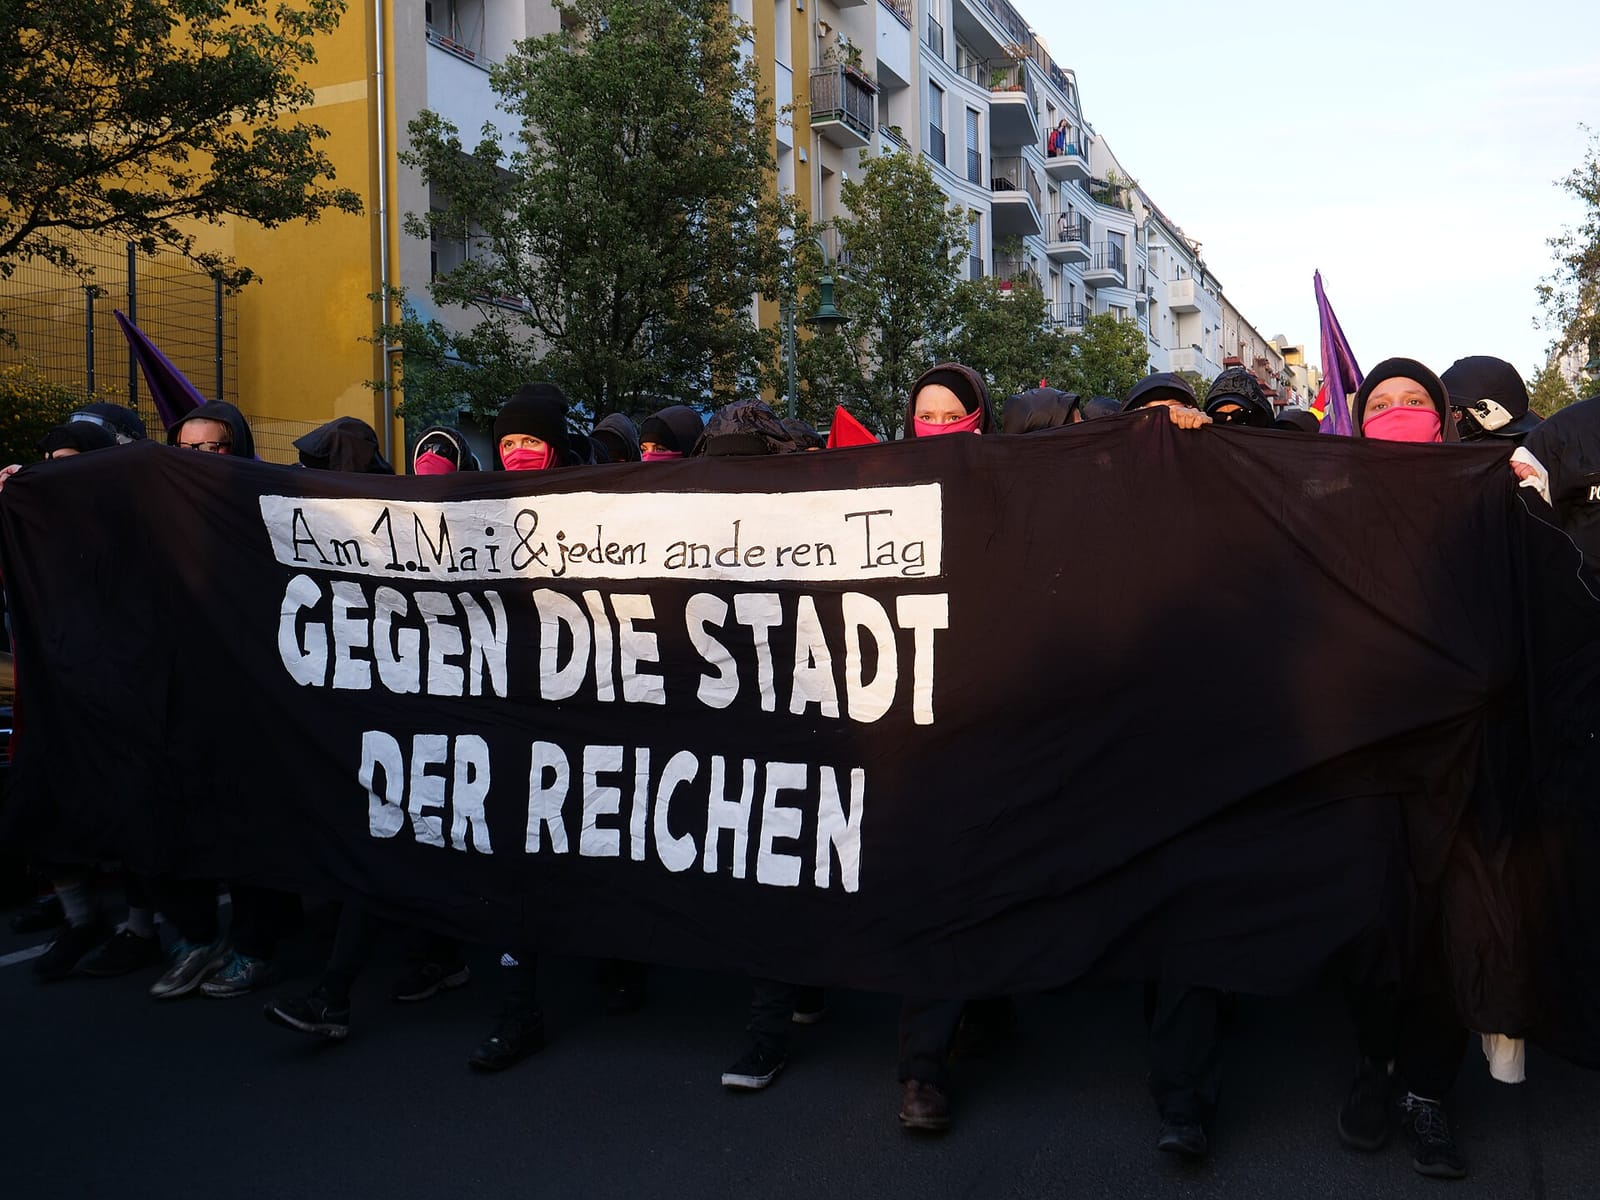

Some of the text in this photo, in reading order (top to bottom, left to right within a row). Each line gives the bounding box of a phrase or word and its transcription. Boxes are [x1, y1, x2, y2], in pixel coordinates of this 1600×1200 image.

[293, 507, 369, 567] Am
[664, 519, 837, 570] anderen
[844, 509, 926, 576] Tag
[277, 573, 949, 725] GEGEN DIE STADT
[358, 730, 865, 892] DER REICHEN
